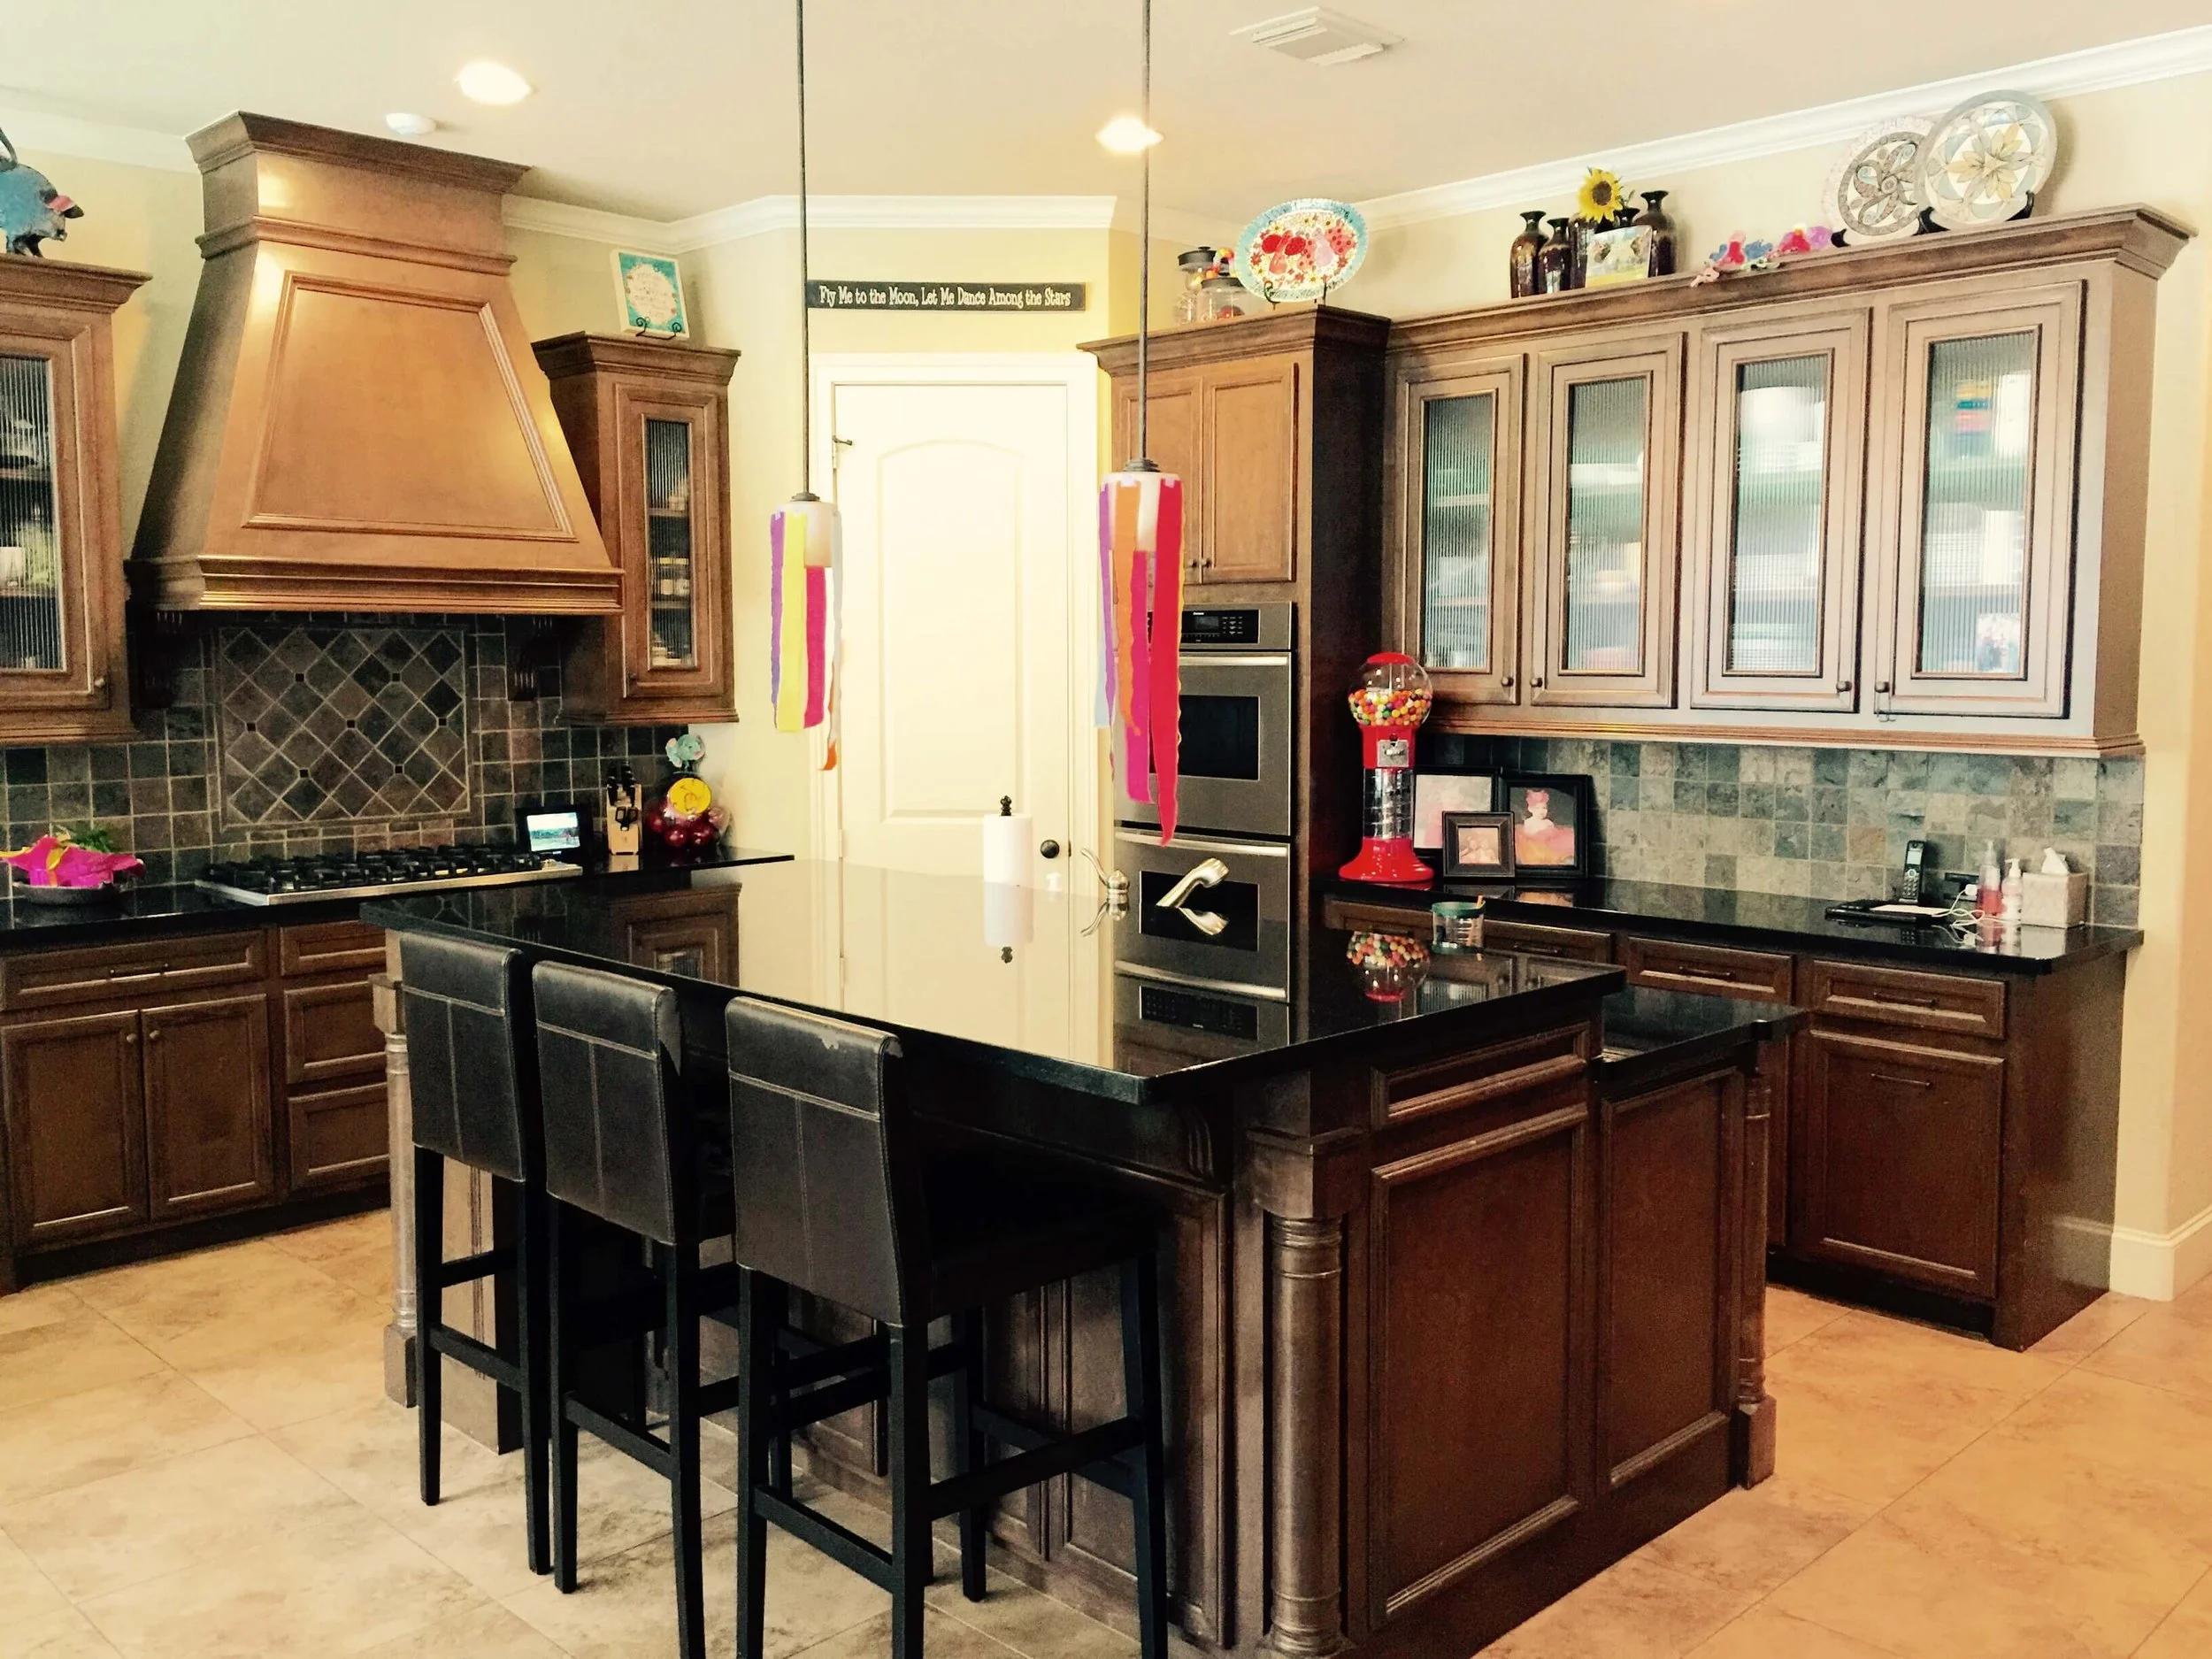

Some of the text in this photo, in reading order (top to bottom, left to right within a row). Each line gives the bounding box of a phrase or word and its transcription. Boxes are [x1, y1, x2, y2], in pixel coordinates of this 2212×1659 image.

[819, 285, 1071, 309] Fly Me to the Moon, Let Me Dance Among the Stars
